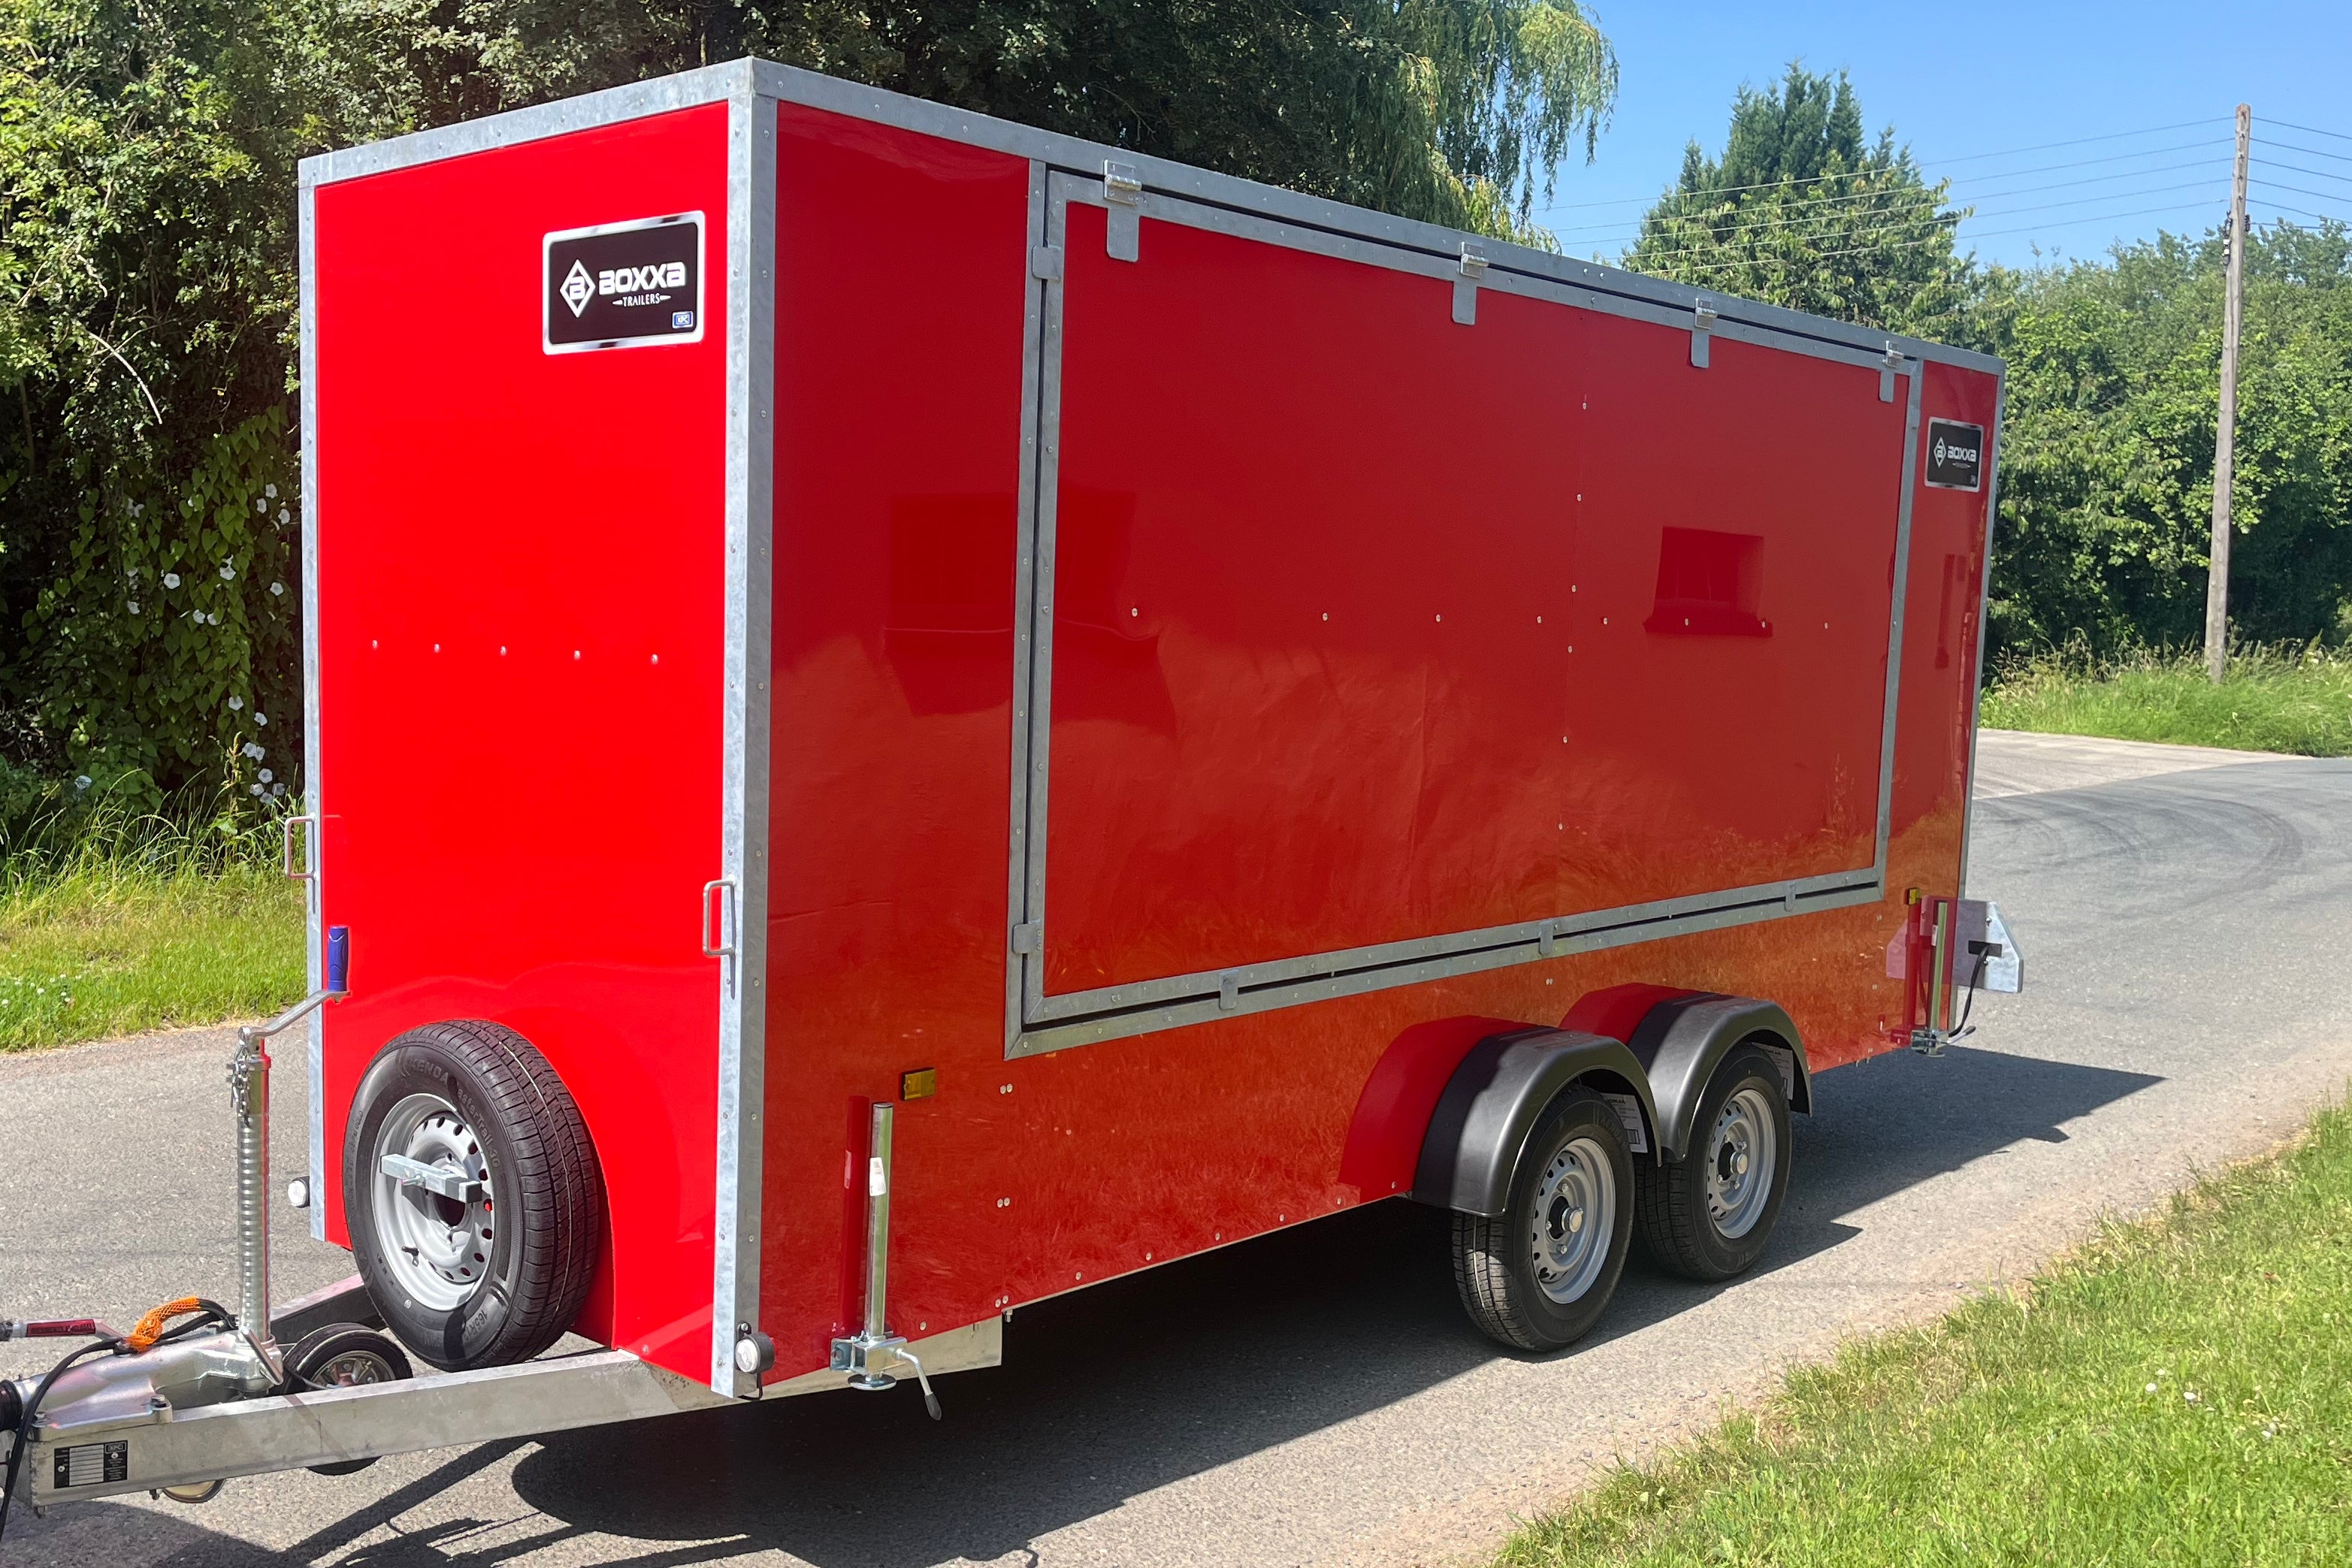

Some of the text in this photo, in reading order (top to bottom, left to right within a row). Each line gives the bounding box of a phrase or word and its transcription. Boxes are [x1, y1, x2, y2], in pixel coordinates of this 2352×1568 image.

[623, 293, 661, 307] TRAILERS
[408, 1057, 449, 1084] KENDA
[456, 1083, 494, 1146] asterTrail
